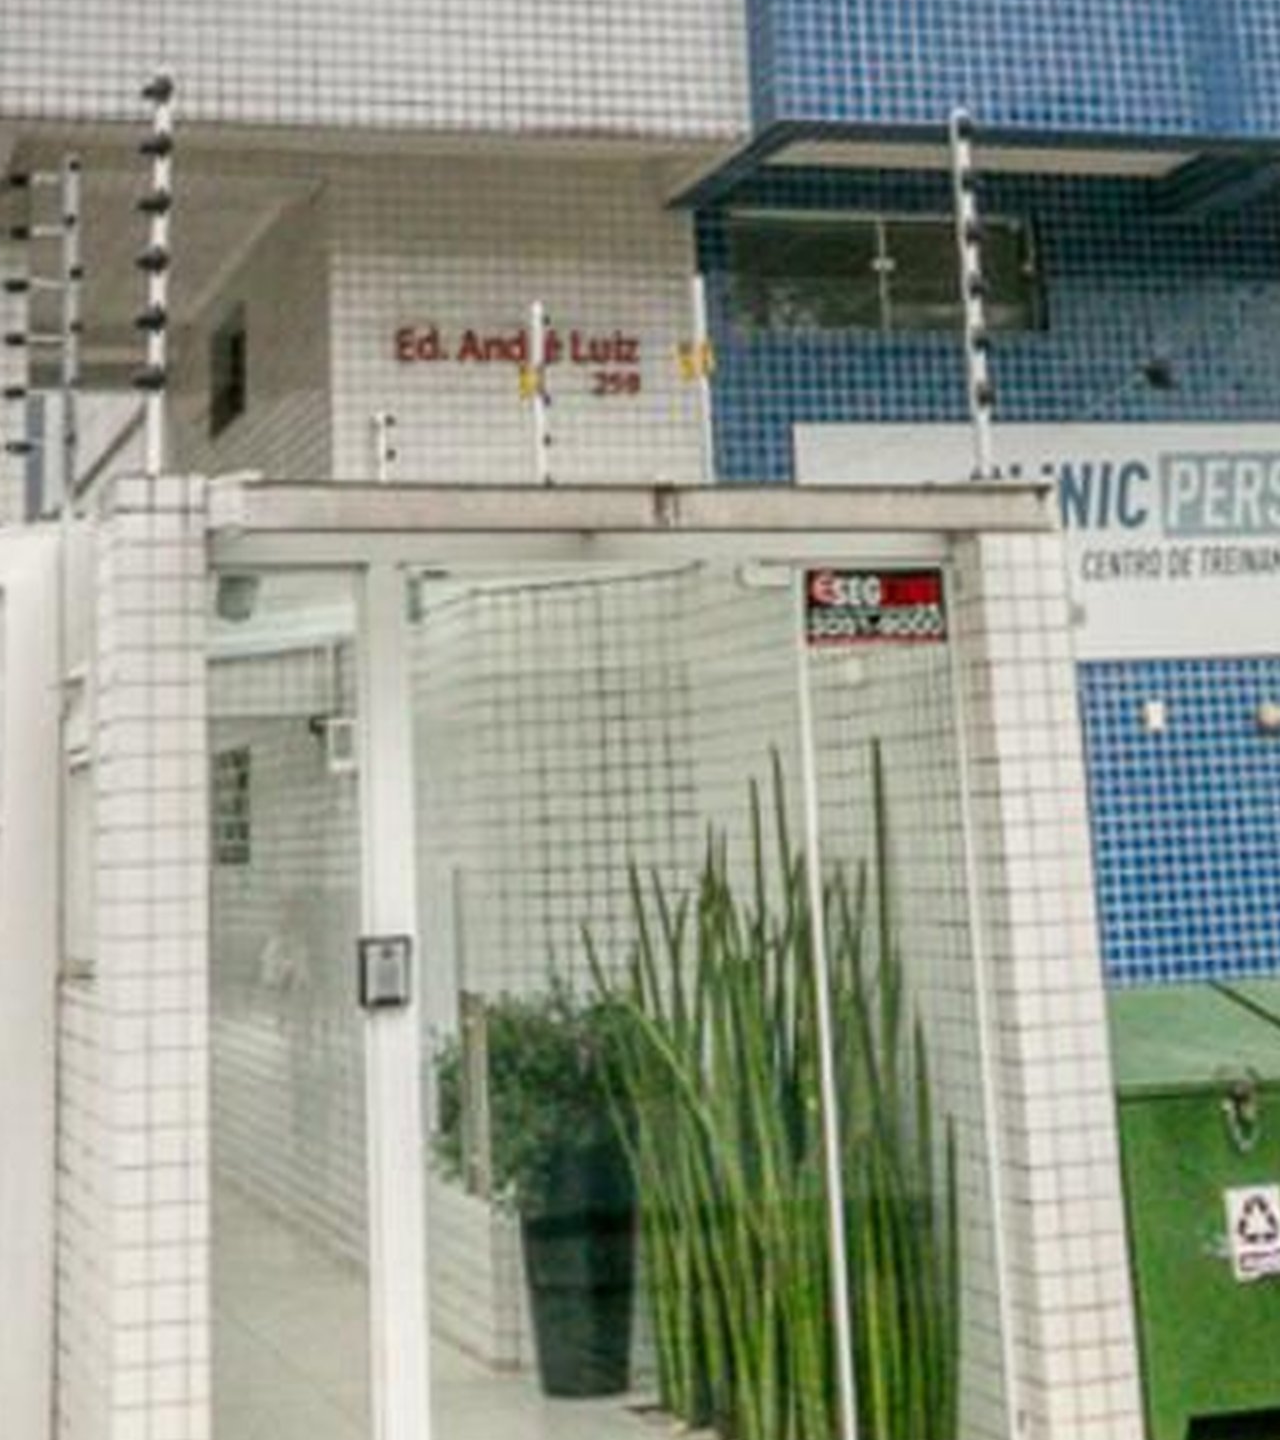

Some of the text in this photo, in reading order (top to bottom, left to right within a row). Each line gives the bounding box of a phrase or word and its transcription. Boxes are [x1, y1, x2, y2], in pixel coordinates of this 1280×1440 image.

[397, 326, 640, 363] Ed. Andé Luiz
[1080, 546, 1162, 581] CENTRO
[1168, 545, 1196, 578] DE
